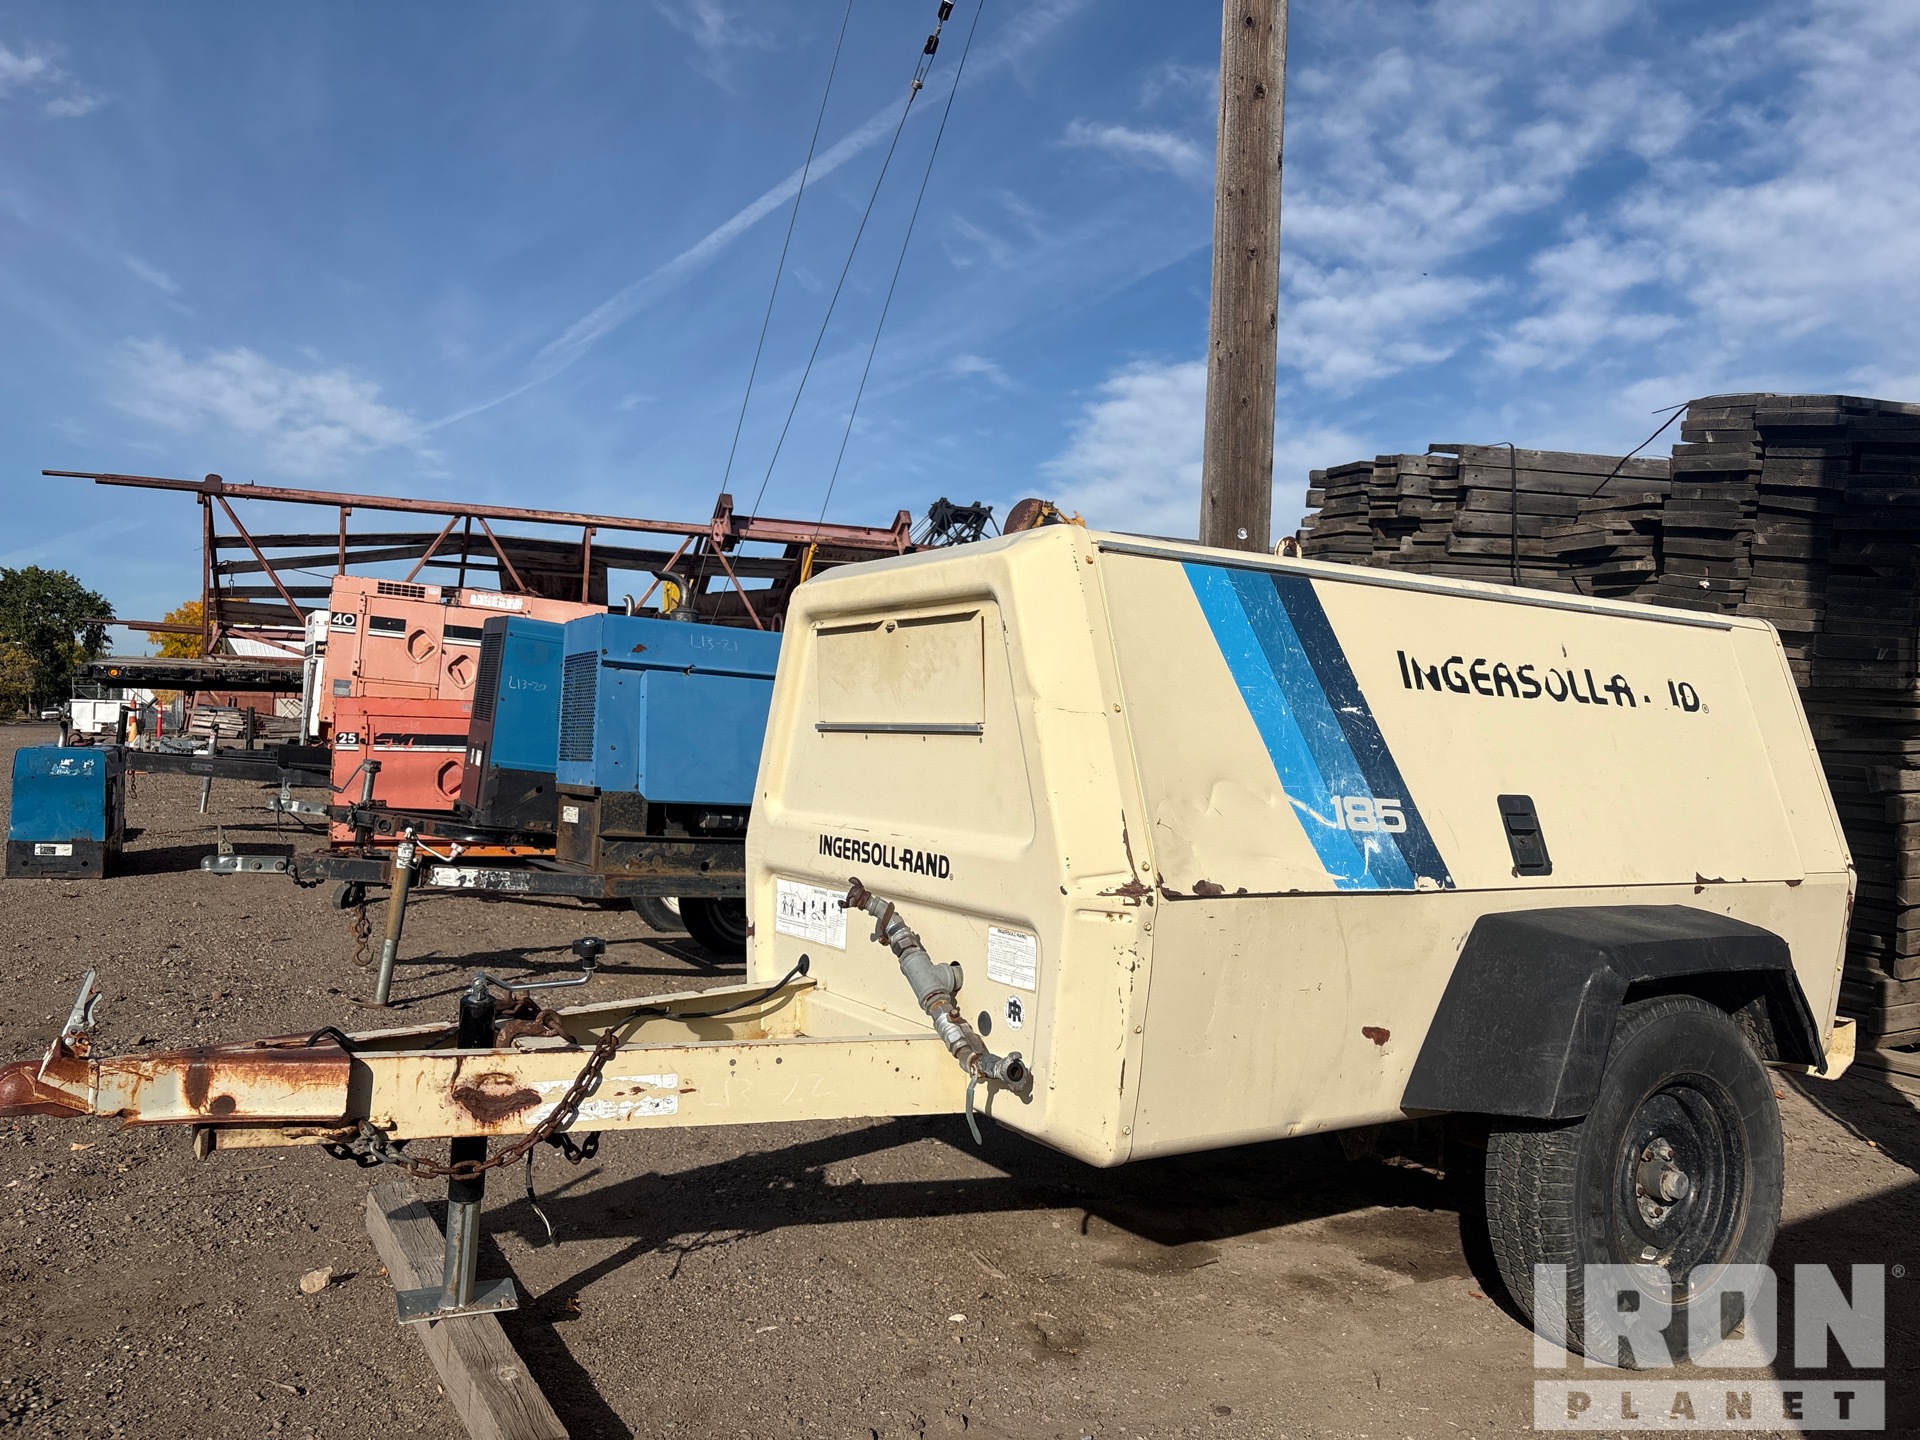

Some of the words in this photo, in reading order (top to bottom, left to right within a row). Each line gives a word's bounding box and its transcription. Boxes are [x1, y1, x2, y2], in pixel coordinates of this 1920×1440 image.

[332, 613, 355, 626] 40
[690, 633, 738, 652] L13-21
[508, 675, 547, 692] L13-20
[338, 733, 357, 744] 25
[1330, 795, 1407, 834] 185
